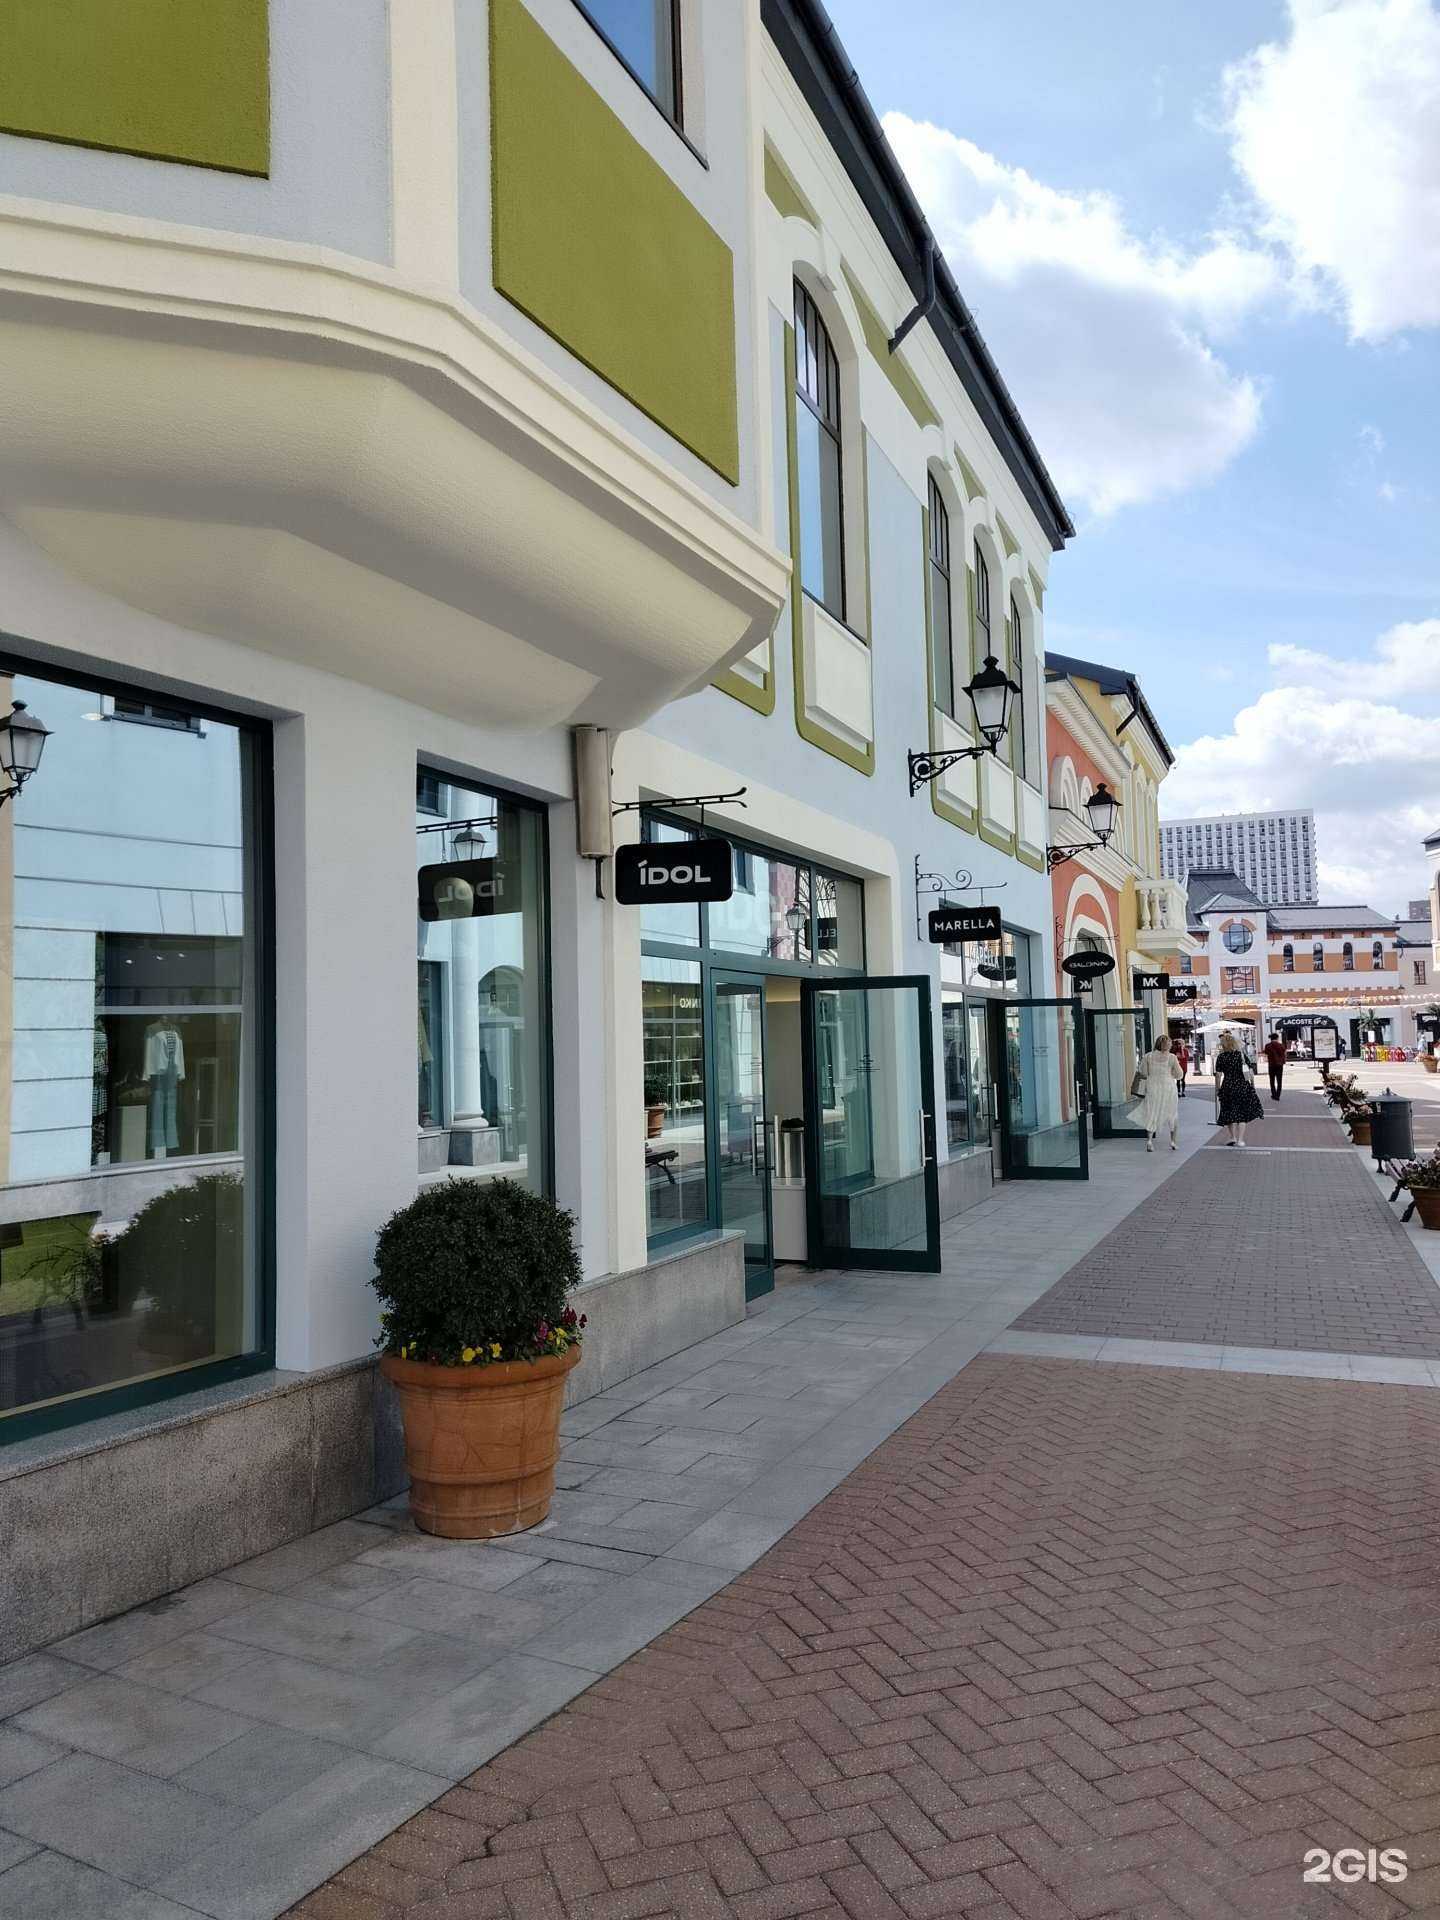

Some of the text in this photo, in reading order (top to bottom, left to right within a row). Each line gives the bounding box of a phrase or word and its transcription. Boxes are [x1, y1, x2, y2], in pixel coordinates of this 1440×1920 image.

[638, 859, 711, 885] ÍDOL
[934, 919, 995, 931] MARELLA
[1143, 977, 1159, 987] MK
[1174, 989, 1188, 997] MK
